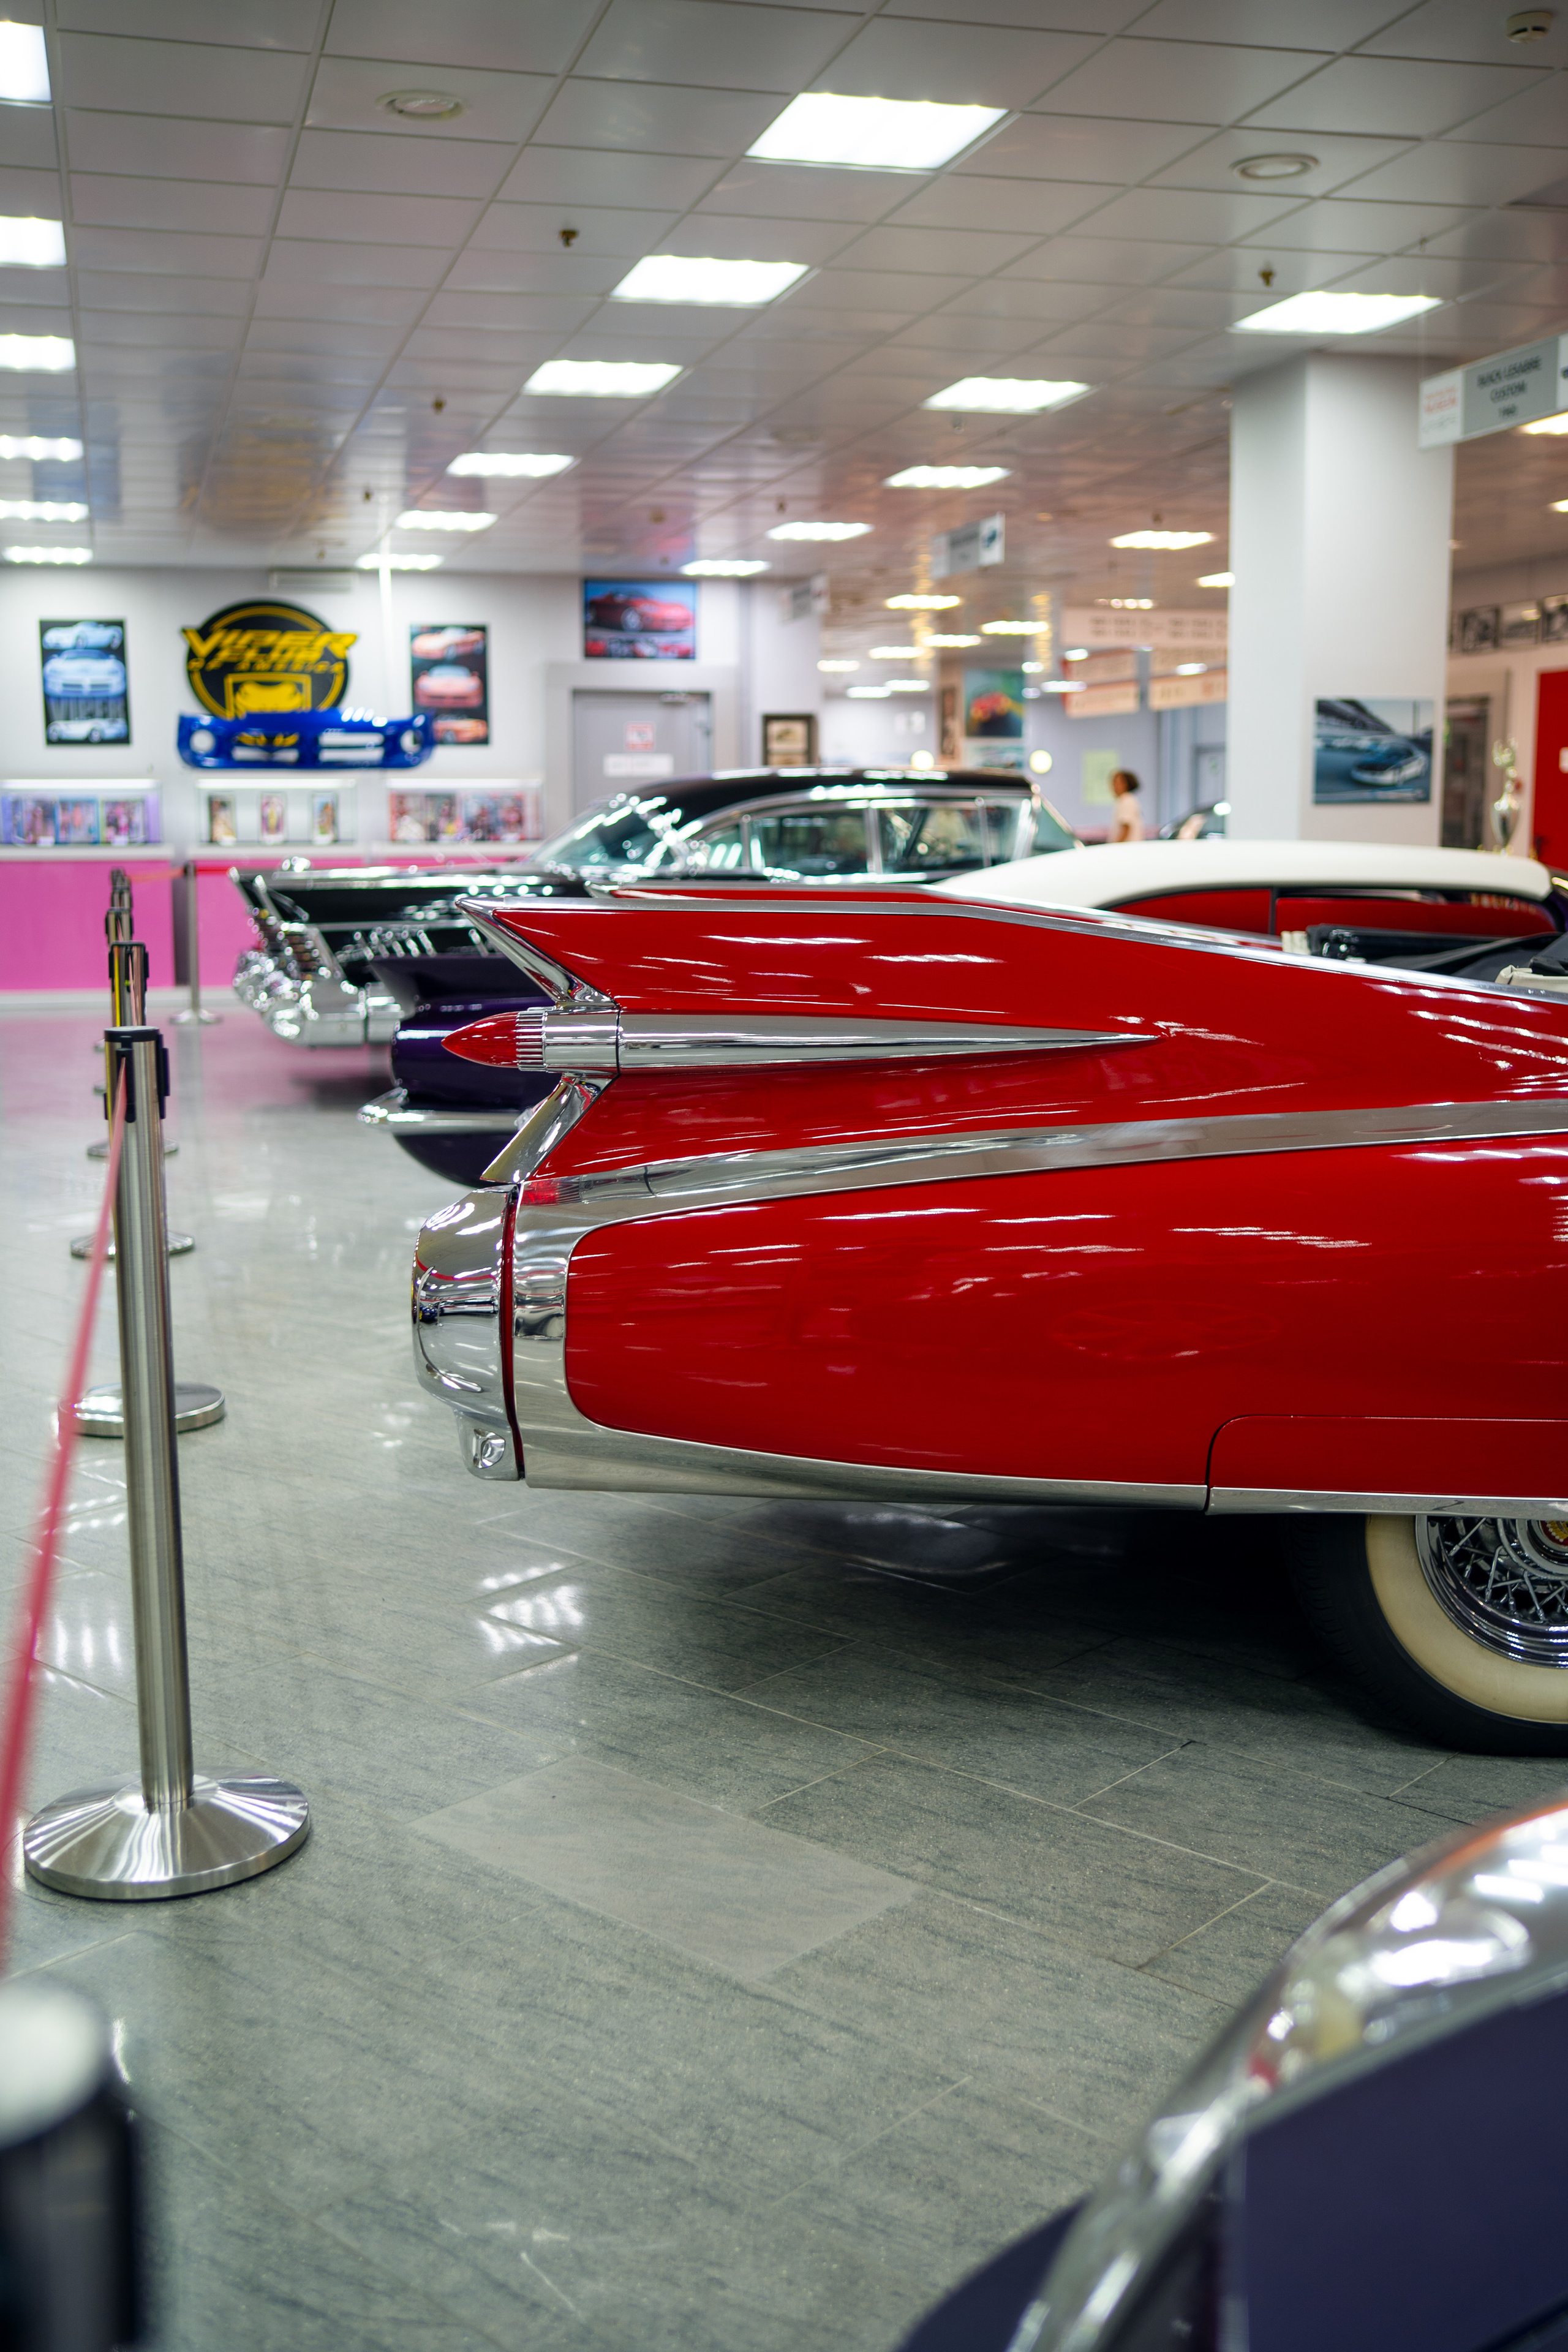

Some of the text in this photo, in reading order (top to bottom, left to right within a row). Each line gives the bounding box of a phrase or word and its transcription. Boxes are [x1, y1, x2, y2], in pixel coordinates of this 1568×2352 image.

[182, 628, 357, 658] VIPER
[187, 658, 345, 673] OF AMERICA
